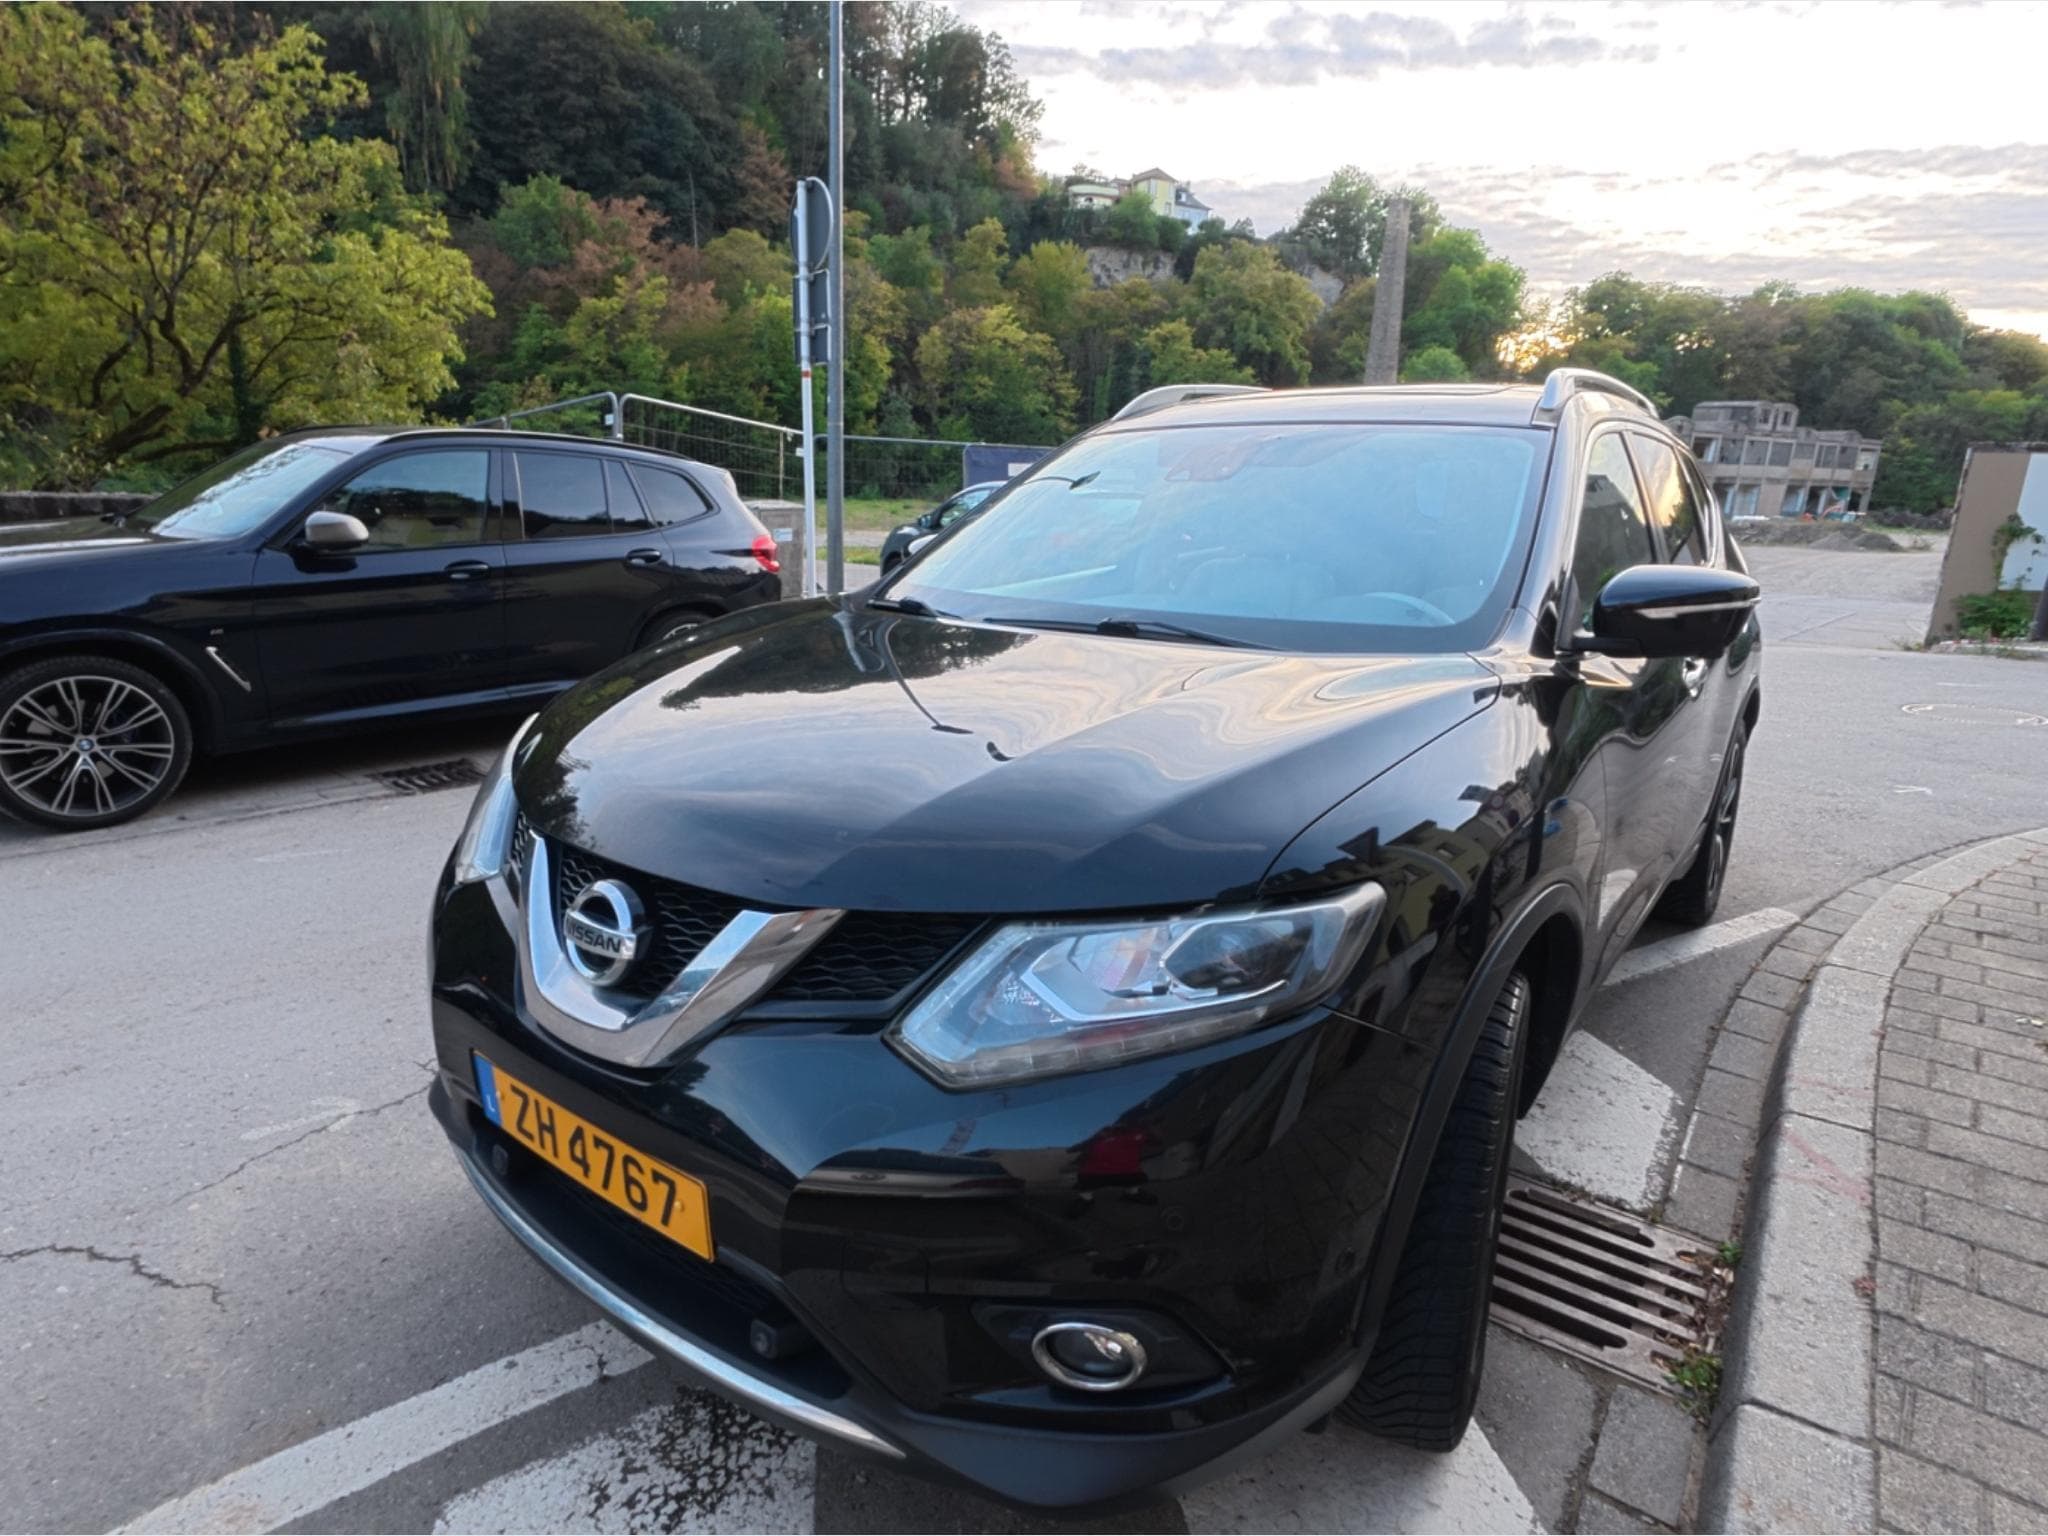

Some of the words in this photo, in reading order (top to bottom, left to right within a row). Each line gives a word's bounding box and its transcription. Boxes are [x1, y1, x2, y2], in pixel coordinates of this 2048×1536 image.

[567, 920, 621, 953] NISSAN
[486, 1094, 496, 1112] L
[510, 1084, 559, 1159] ZH
[569, 1125, 677, 1227] 4767
